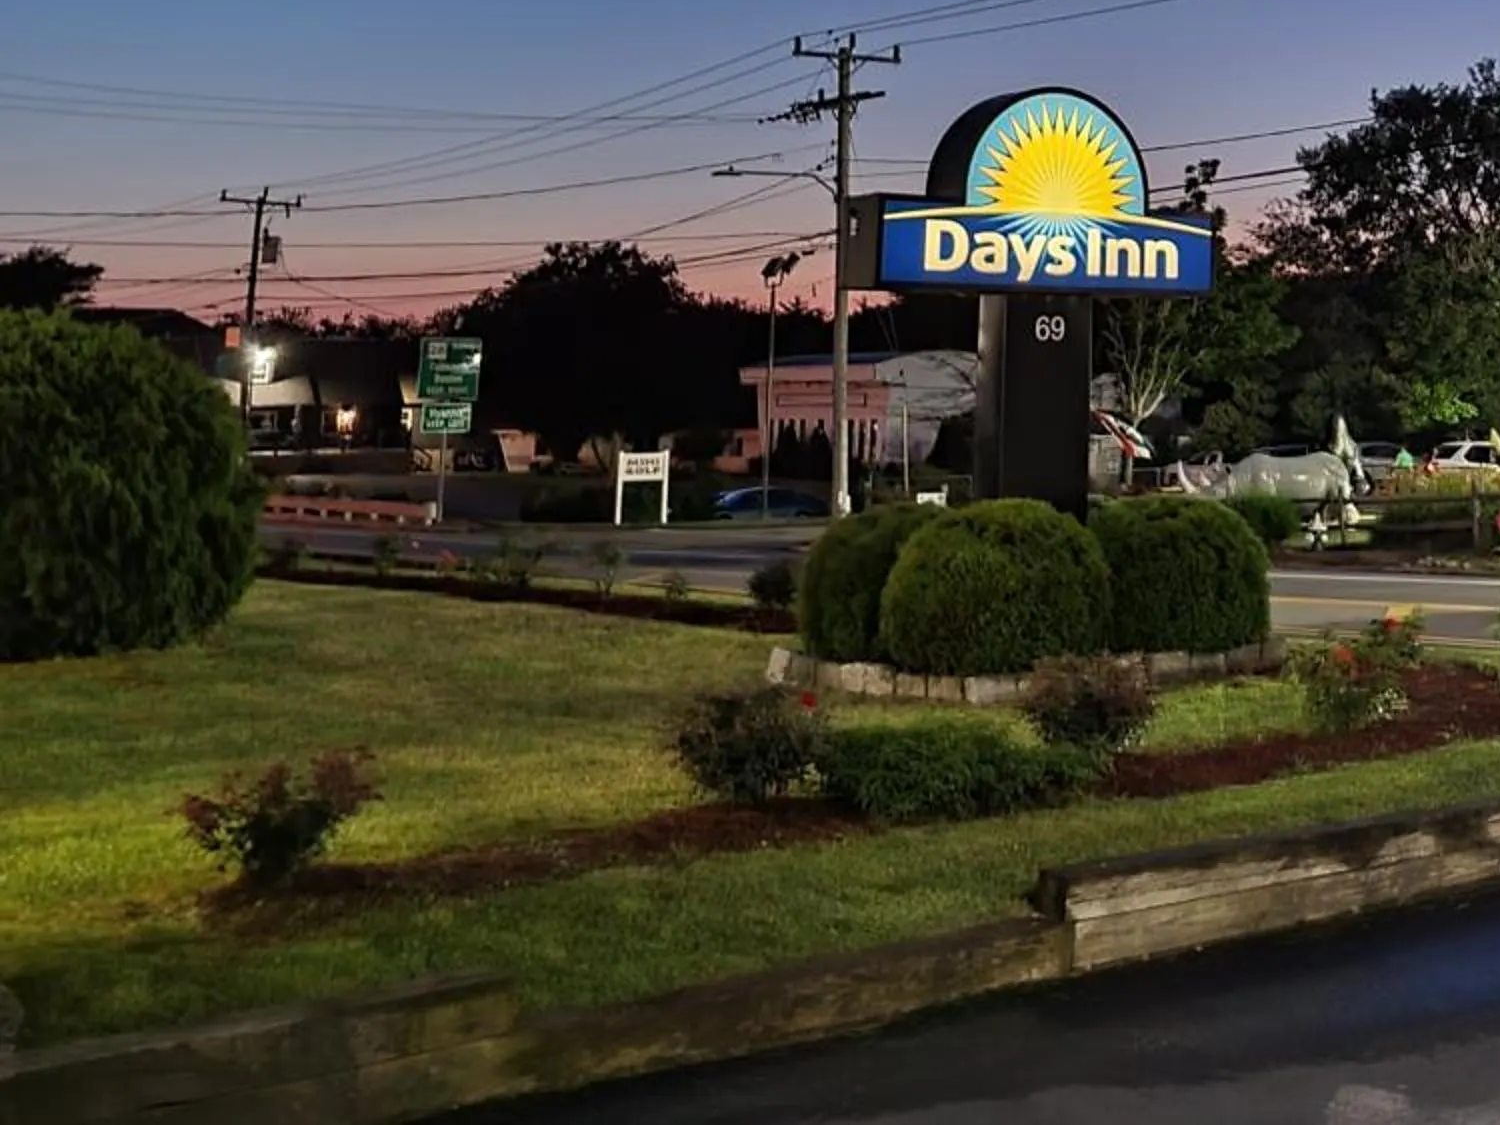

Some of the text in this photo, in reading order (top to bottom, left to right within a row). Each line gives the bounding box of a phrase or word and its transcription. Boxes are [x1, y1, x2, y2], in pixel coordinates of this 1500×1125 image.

[924, 219, 1179, 282] Days Inn
[1035, 316, 1065, 341] 69
